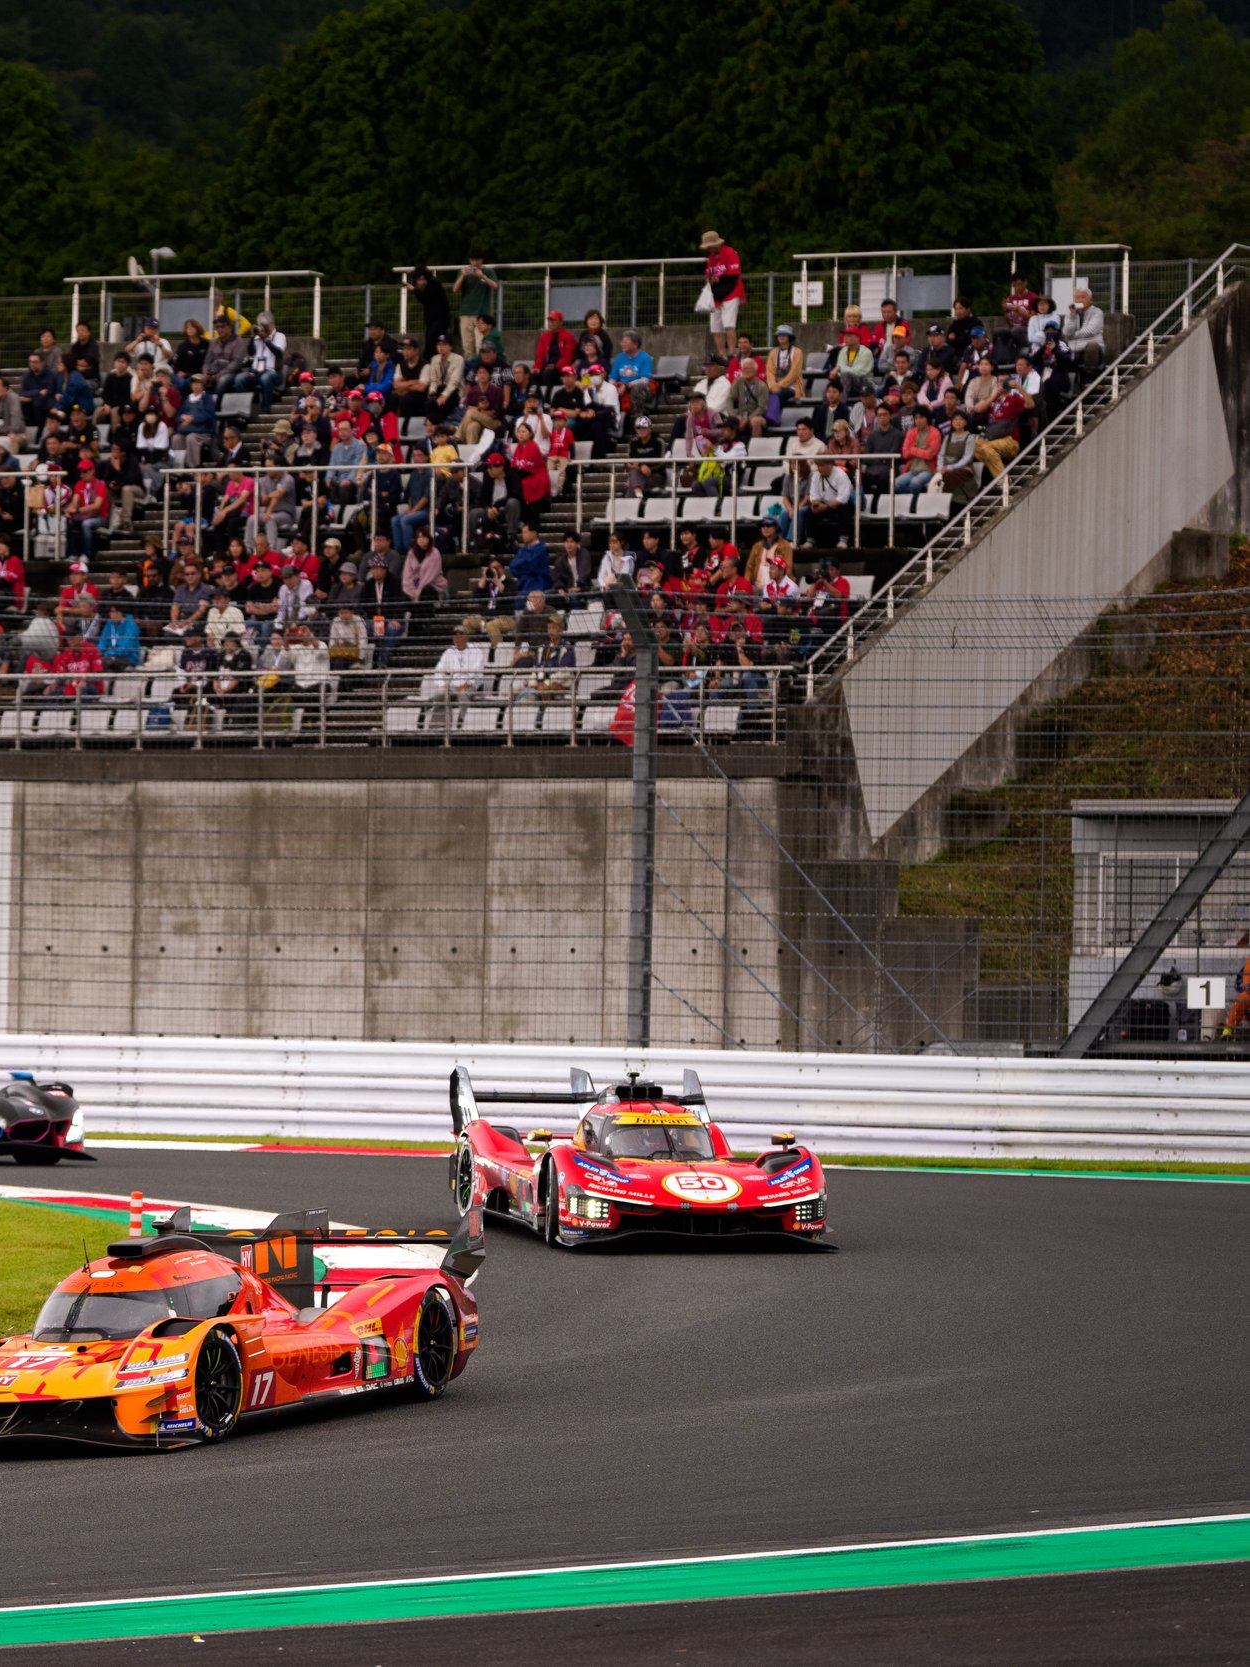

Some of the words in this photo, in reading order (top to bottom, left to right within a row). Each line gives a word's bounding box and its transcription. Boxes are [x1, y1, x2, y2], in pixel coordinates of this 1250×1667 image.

[1199, 979, 1212, 1007] 1
[636, 1117, 689, 1125] Ferrari
[577, 1161, 600, 1175] ADLER
[606, 1173, 630, 1184] GROUP
[588, 1182, 627, 1196] RICHARD
[628, 1191, 656, 1199] MILLE
[678, 1177, 725, 1190] 50
[756, 1191, 791, 1202] RICHARD
[790, 1186, 812, 1195] MILLE
[579, 1220, 611, 1228] V-Power
[241, 1250, 252, 1267] HY
[67, 1280, 125, 1289] GENESIS
[355, 1321, 382, 1336] DHL
[269, 1336, 343, 1370] GENESIS
[6, 1356, 61, 1369] 17
[251, 1371, 274, 1407] 17
[166, 1421, 194, 1429] MICHELIN
